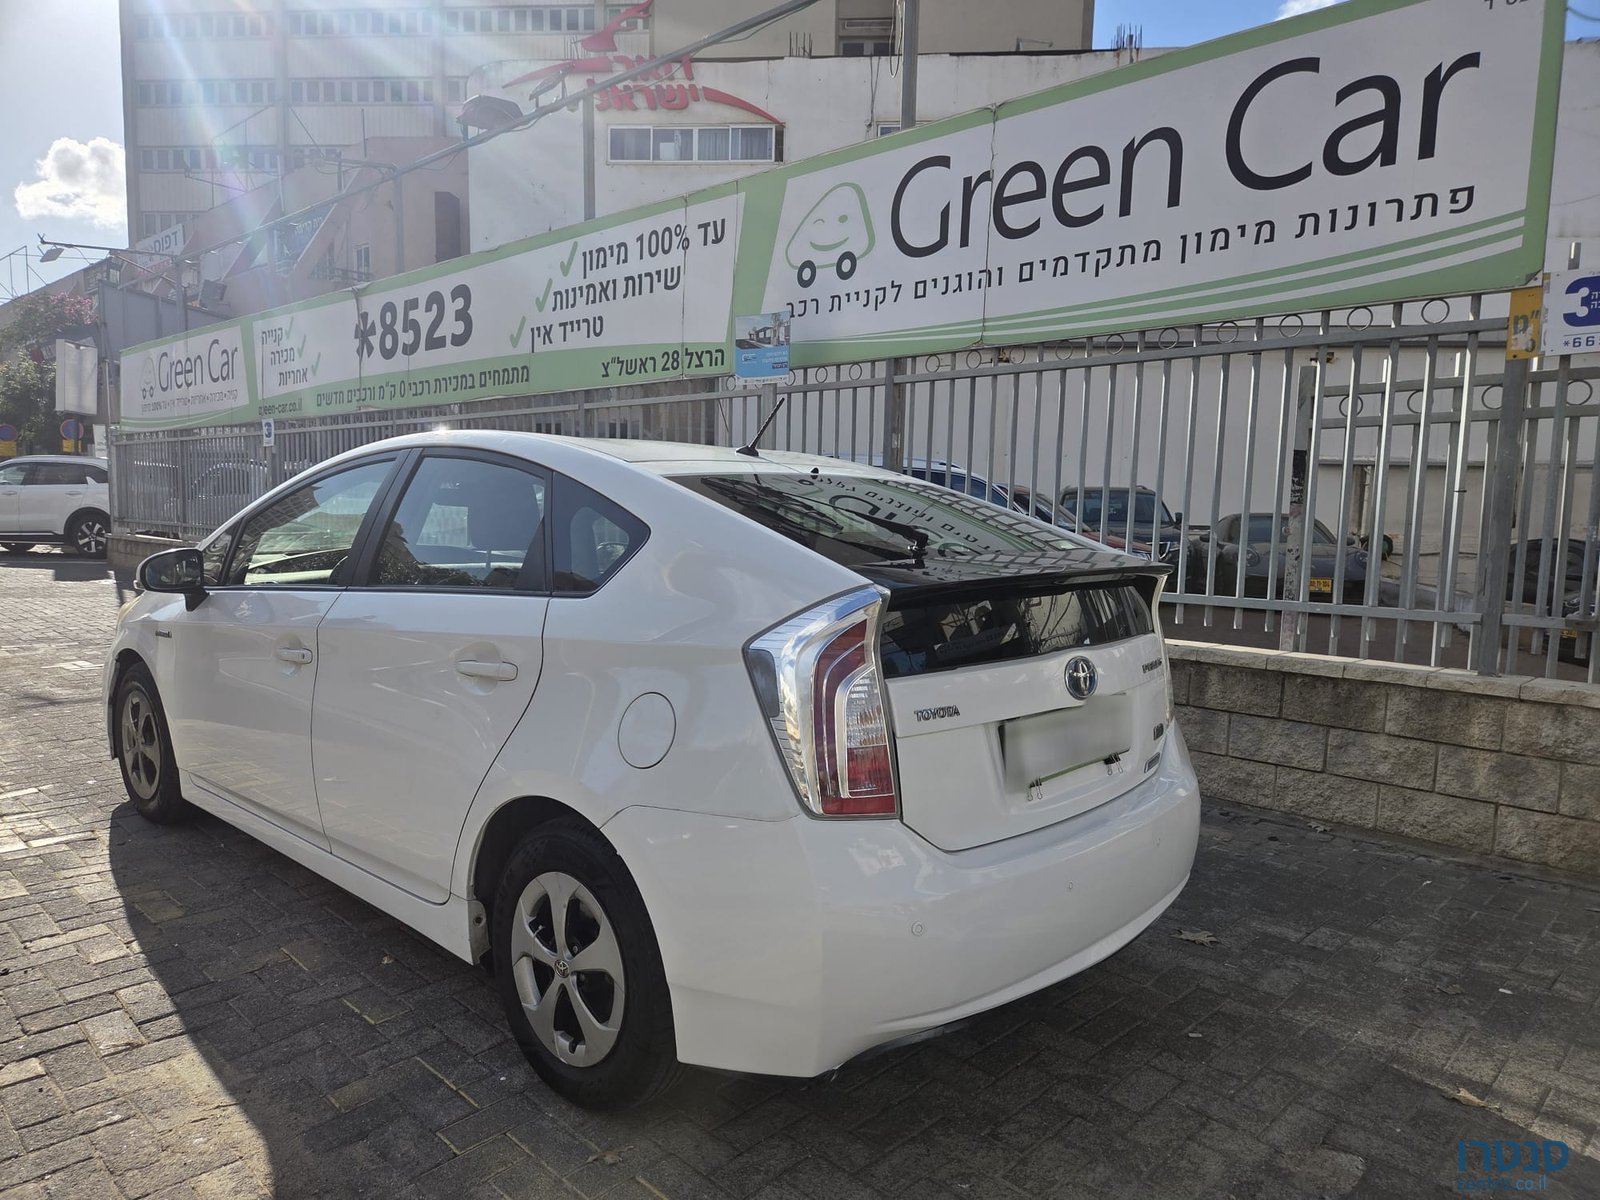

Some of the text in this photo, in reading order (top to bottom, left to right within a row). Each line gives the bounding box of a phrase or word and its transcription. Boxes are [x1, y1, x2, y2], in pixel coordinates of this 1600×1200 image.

[890, 50, 1481, 259] Green Car
[582, 218, 726, 279] עד 100% מימון
[786, 185, 1475, 318] פתרונות מימון מתקדמים והוגנים לקניית רכב
[552, 265, 682, 312] שירות ואמינות
[261, 327, 283, 347] קנייה
[530, 315, 604, 353] טרייד אין
[158, 338, 239, 392] Green Car
[270, 347, 295, 366] מכירה
[660, 350, 680, 372] 28
[684, 347, 725, 369] הרצל
[278, 367, 308, 387] אחריות
[433, 373, 476, 395] במכירת
[479, 364, 530, 388] מתמחים
[316, 389, 345, 407] חדשים
[346, 387, 376, 405] ורכבים
[399, 381, 406, 399] 0
[408, 380, 431, 398] רכבי
[913, 704, 961, 722] TOYOTA
